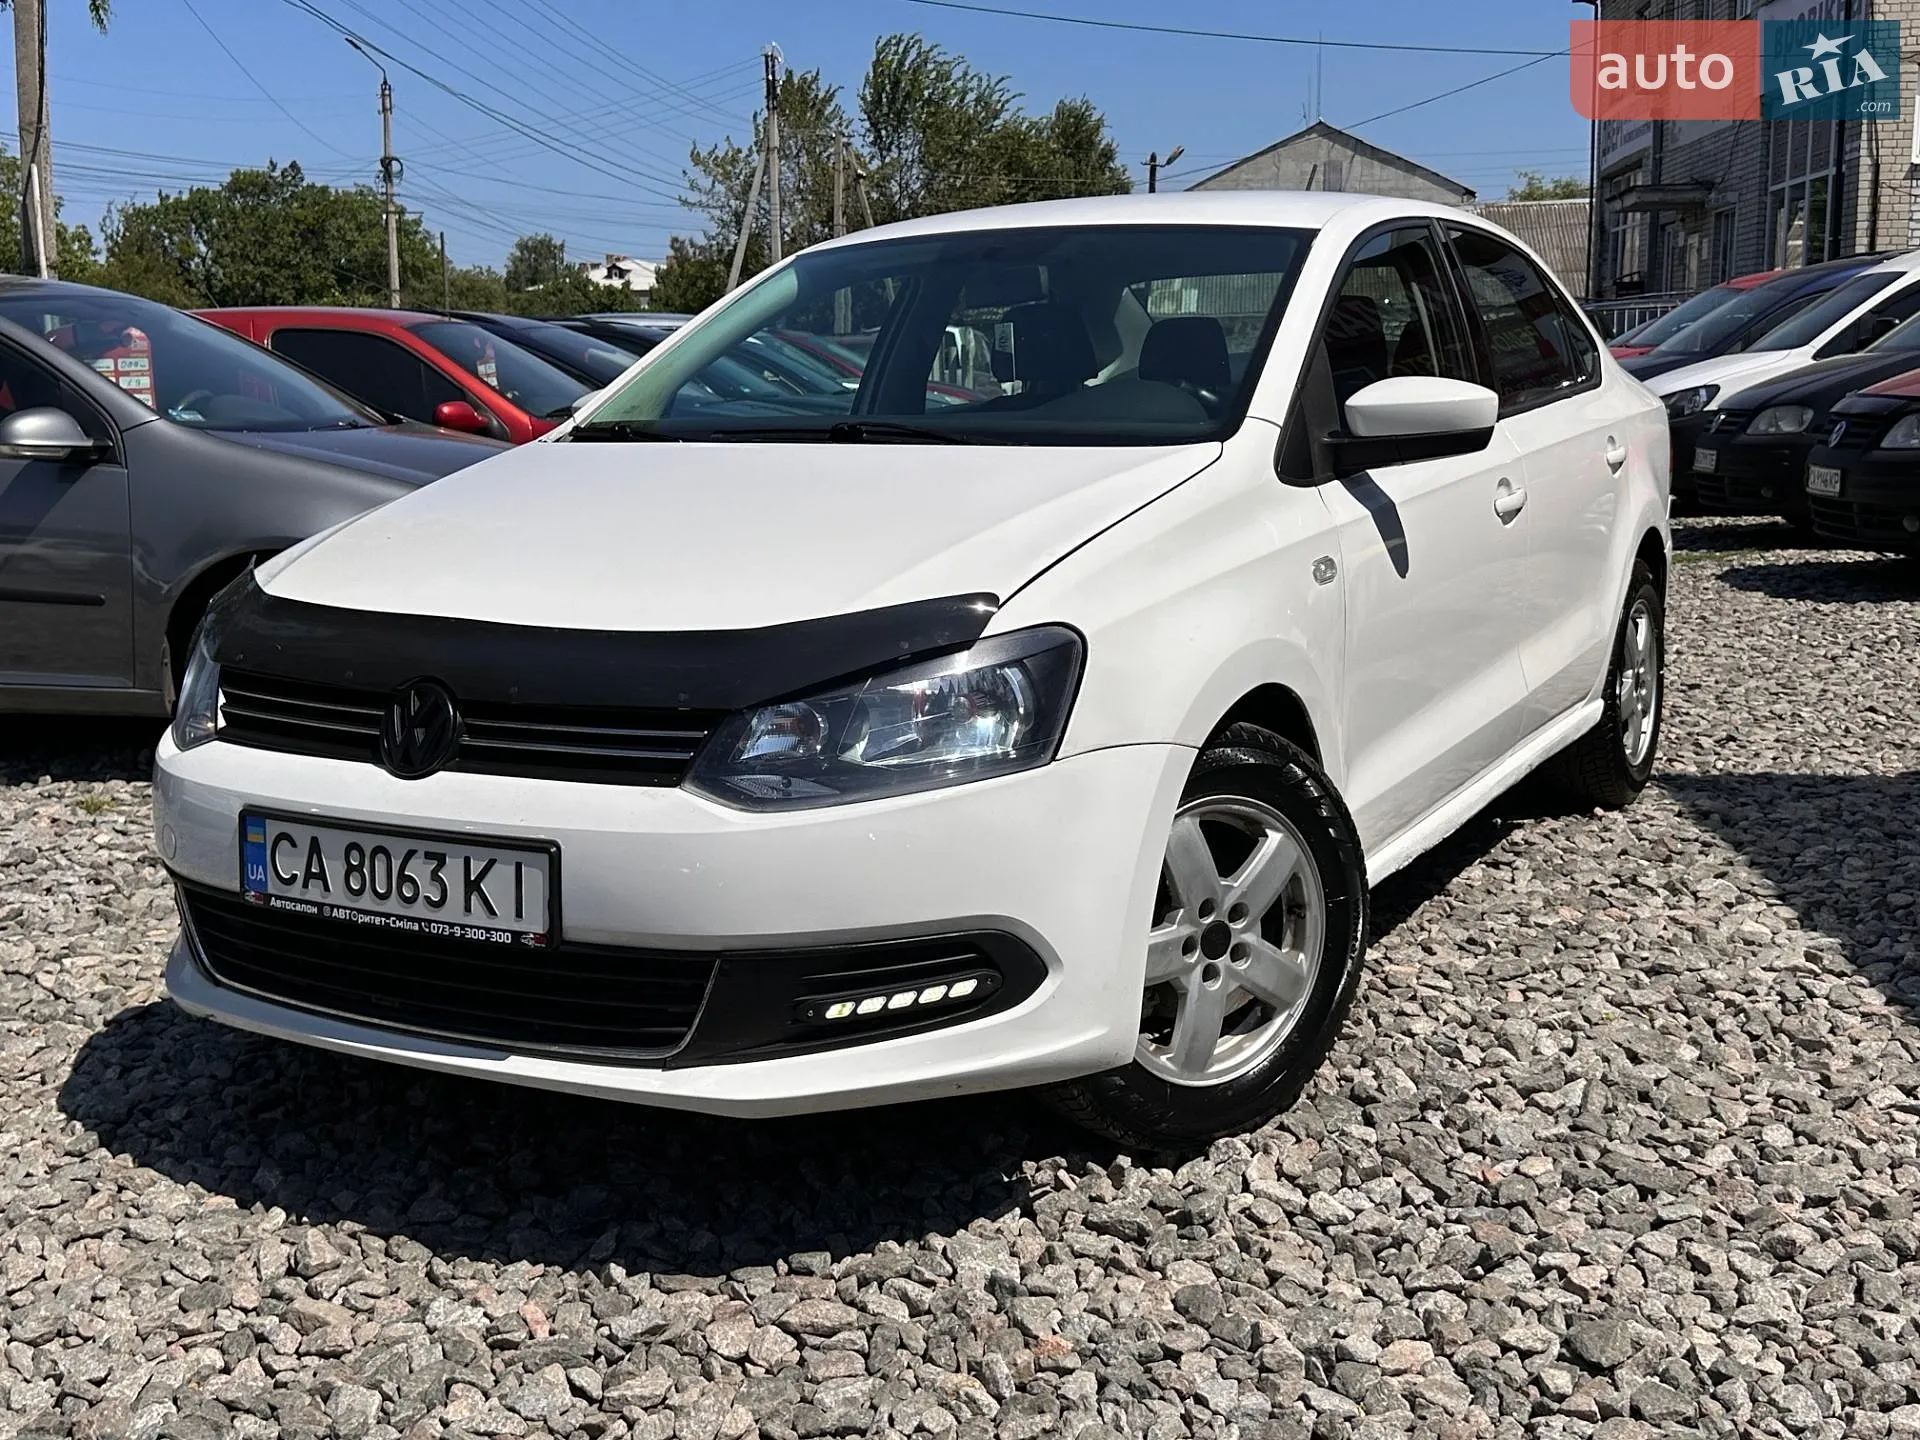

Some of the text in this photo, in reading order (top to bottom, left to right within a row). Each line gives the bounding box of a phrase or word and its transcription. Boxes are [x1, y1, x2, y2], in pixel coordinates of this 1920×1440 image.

[248, 863, 266, 881] UA
[271, 832, 524, 920] CA 8063 KI
[269, 896, 318, 914] Автосалон
[430, 922, 512, 944] 073-9-300-300
